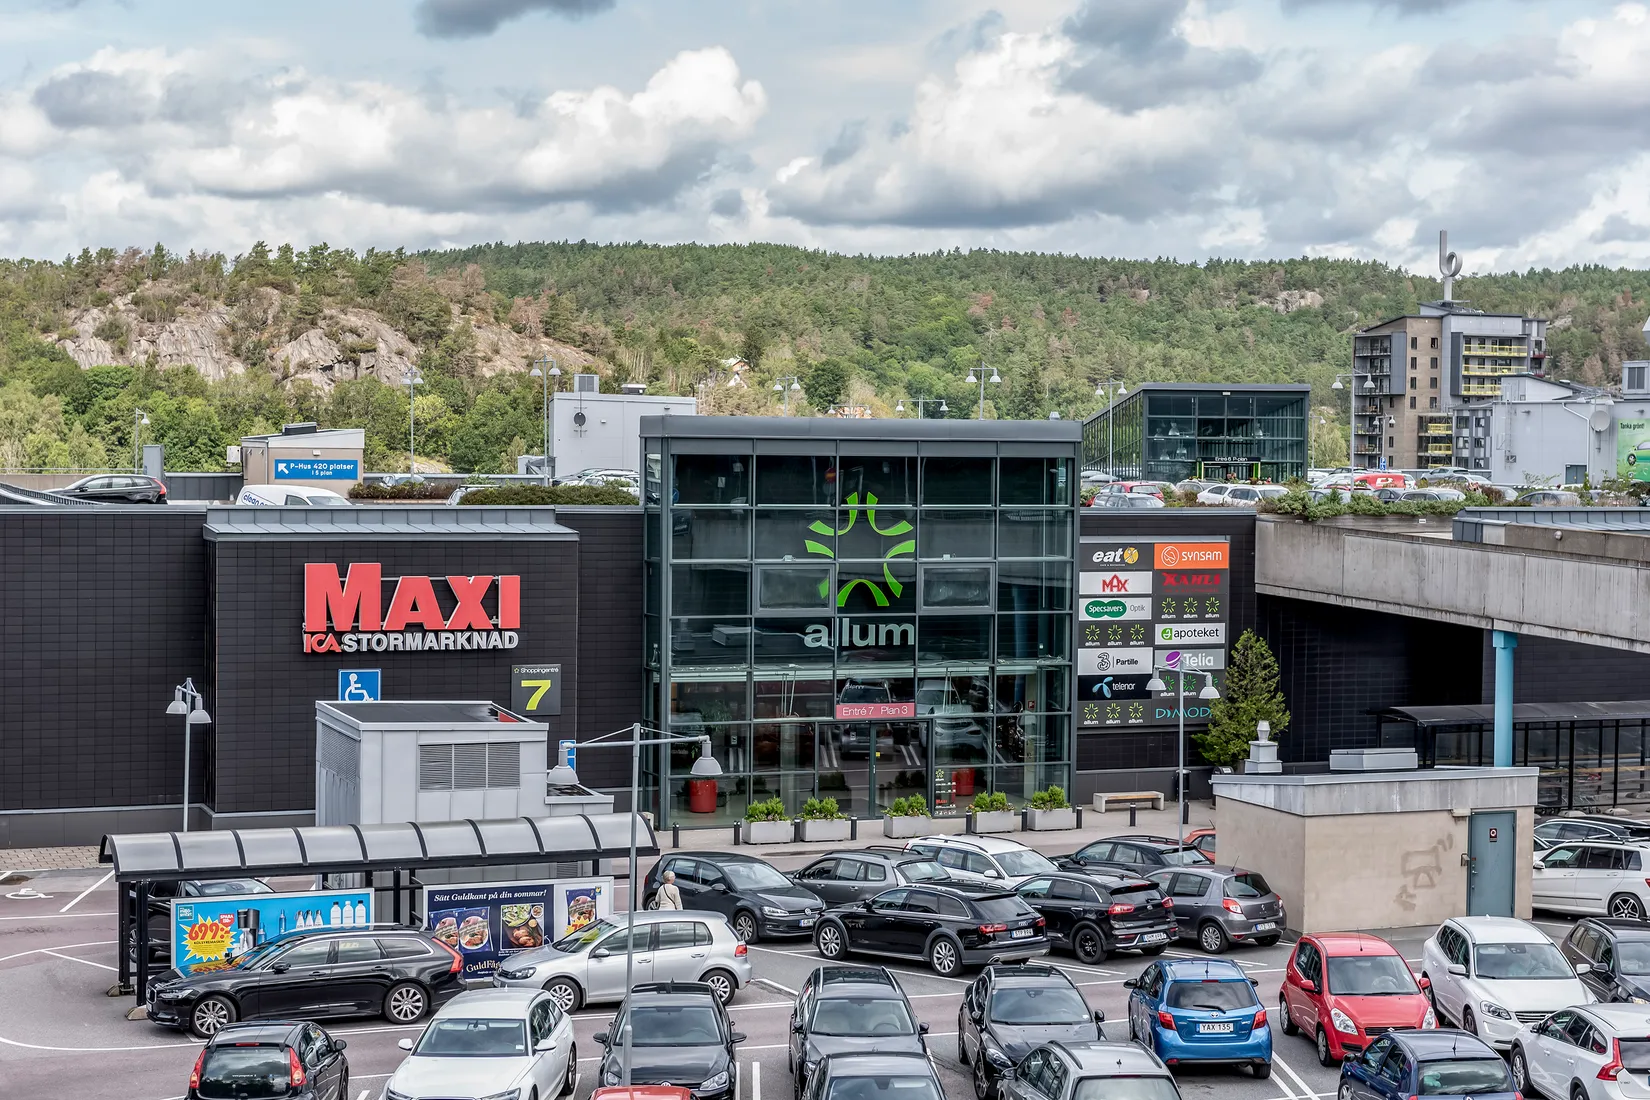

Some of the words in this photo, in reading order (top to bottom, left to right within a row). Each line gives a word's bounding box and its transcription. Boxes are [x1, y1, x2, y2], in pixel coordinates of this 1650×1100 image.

[1092, 548, 1123, 563] eat
[1181, 551, 1222, 561] SYNSAM
[1101, 574, 1130, 592] MAX
[304, 563, 521, 631] MAXI
[1088, 603, 1124, 614] Specsavers
[1129, 605, 1146, 613] Optik
[1174, 628, 1220, 640] apoteket
[303, 633, 342, 653] ICA
[343, 631, 519, 653] STORMARKNAD
[1183, 654, 1214, 666] Telia
[1112, 682, 1136, 691] telenor
[521, 680, 551, 710] 7
[842, 707, 867, 716] Entré
[868, 707, 875, 715] 7
[880, 706, 900, 715] Plan
[901, 706, 908, 714] 3
[434, 894, 450, 902] Sätt
[451, 892, 487, 901] Guldkant
[488, 891, 498, 900] på
[500, 891, 512, 899] din
[513, 889, 547, 898] sommar!
[188, 922, 230, 941] 699:-
